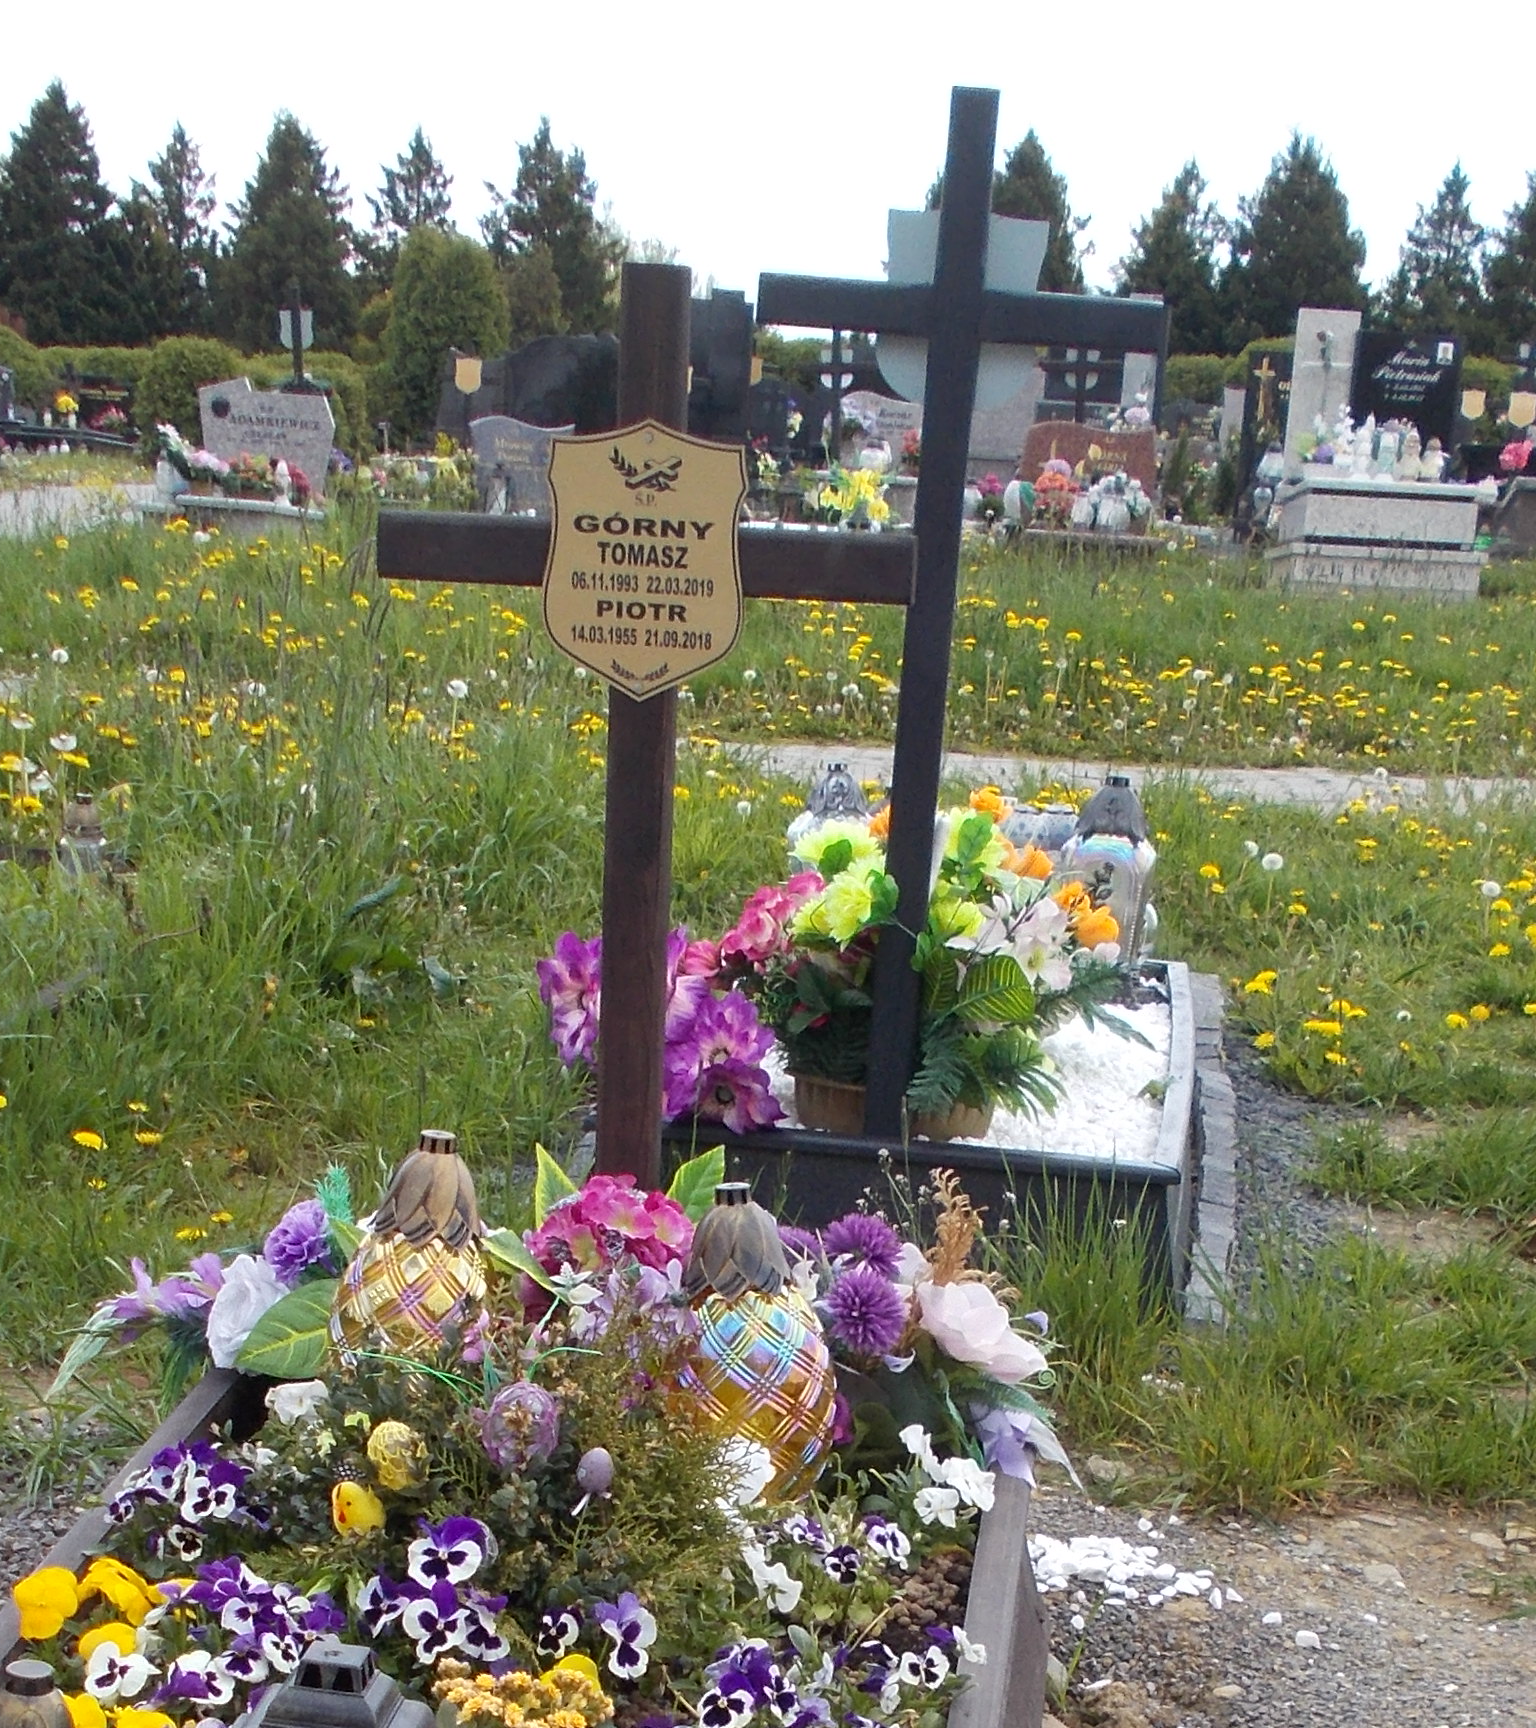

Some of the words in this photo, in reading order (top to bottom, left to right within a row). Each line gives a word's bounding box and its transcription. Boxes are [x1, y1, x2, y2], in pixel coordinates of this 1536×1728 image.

[573, 512, 715, 541] GÓRNY
[597, 541, 689, 569] TOMASZ
[571, 571, 639, 593] 06.11.1993
[646, 576, 714, 597] 22.03.2019
[596, 600, 687, 623] PIOTR
[571, 625, 637, 645] 14.03.1955
[645, 629, 712, 650] 21.09.2018
